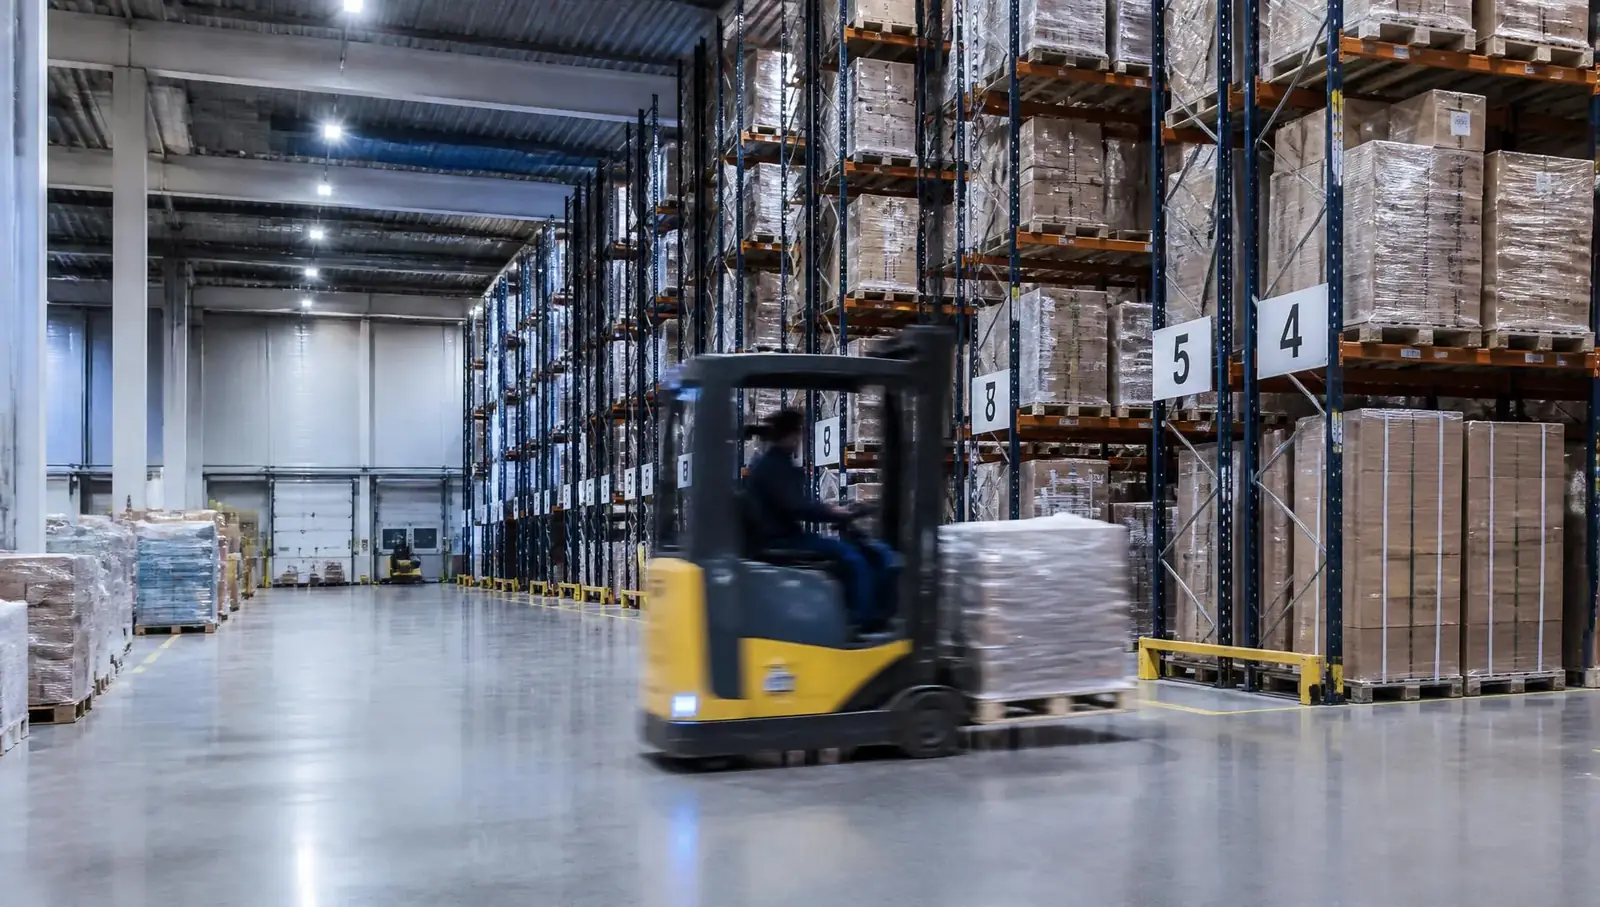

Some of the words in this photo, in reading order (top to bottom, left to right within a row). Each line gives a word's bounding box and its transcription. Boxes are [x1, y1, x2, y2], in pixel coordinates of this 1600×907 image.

[1280, 303, 1302, 358] 4
[1173, 333, 1190, 384] 5
[824, 426, 831, 457] 8
